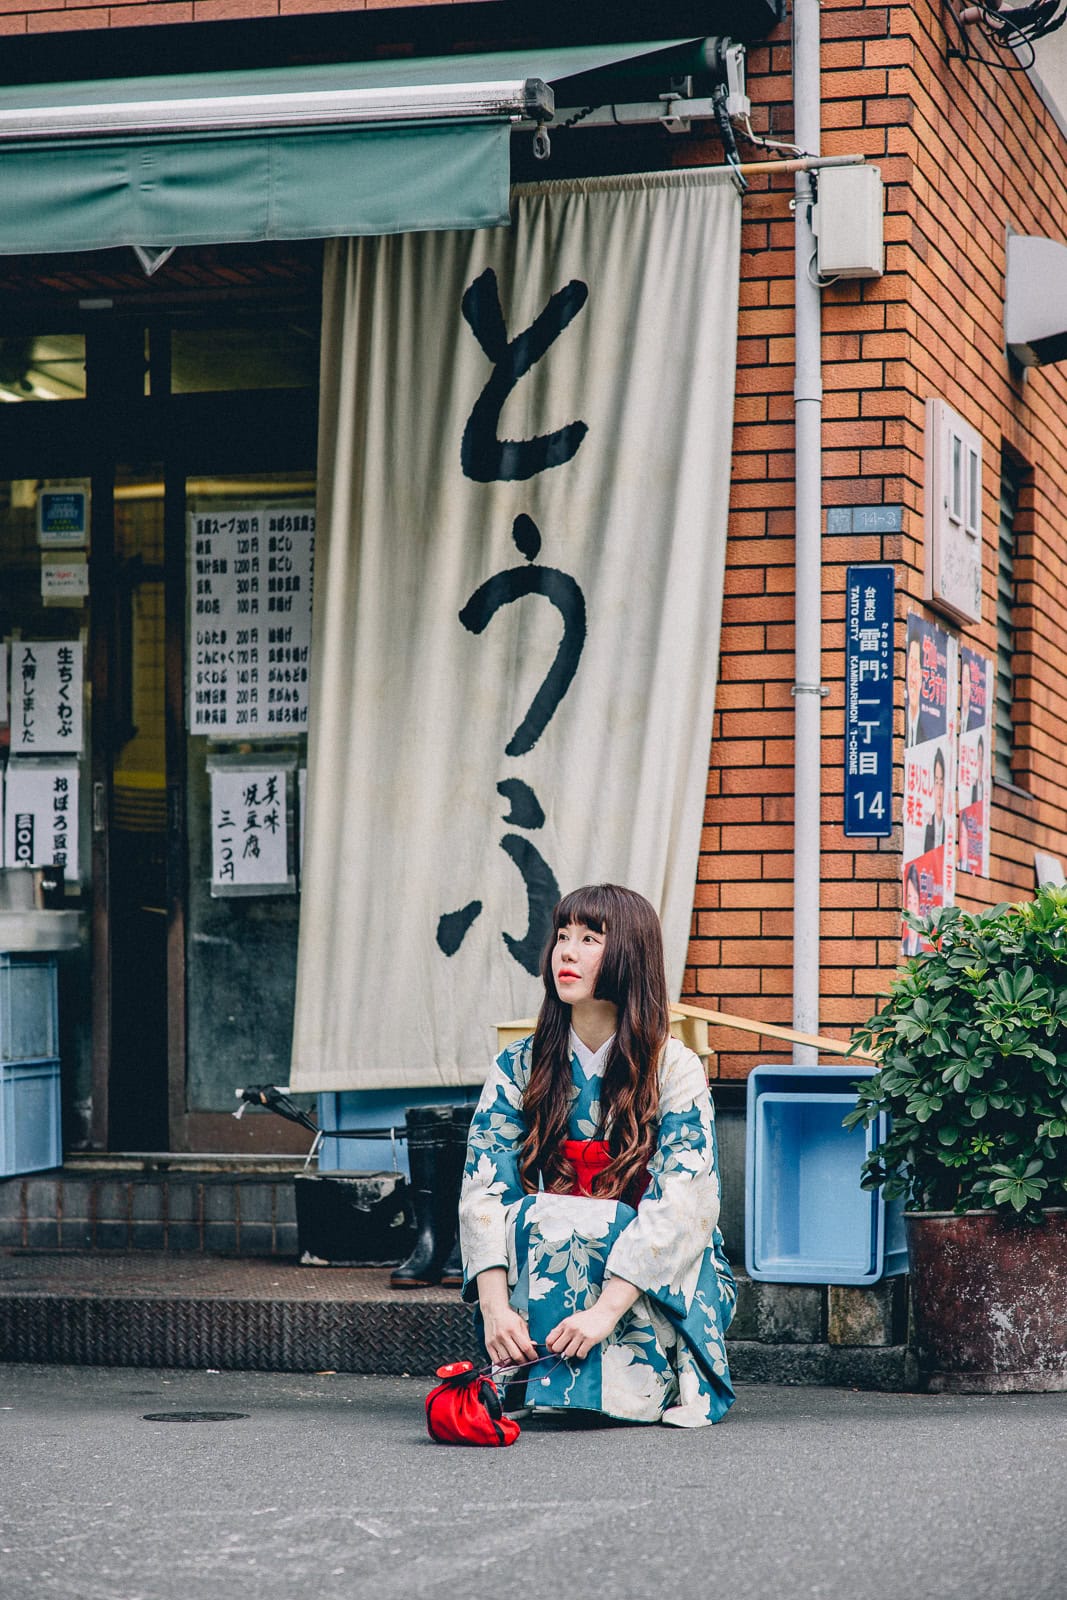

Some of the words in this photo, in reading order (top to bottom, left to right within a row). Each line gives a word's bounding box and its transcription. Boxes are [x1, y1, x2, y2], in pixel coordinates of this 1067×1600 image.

[196, 518, 235, 535] 豆腐スープ
[236, 517, 259, 534] 300円
[269, 515, 308, 532] おぼろ豆腐
[862, 511, 896, 528] 14-3
[237, 537, 258, 554] 120円
[234, 557, 259, 574] 1200円
[236, 577, 258, 594] 300円
[237, 598, 258, 614] 100円
[850, 586, 860, 616] TAITO
[864, 586, 876, 621] 台東区
[437, 267, 589, 977] とうふ
[850, 618, 859, 641] CITY
[236, 628, 258, 645] 200円
[197, 650, 234, 665] こんにゃく
[237, 668, 258, 684] 140円
[268, 667, 307, 682] がんもどき
[22, 647, 37, 743] 入荷しました
[57, 647, 73, 737] 生ちくわぶ
[236, 688, 258, 704] 200円
[849, 656, 859, 722] KAMINARIMON
[857, 628, 881, 776] 雷門一丁目
[236, 708, 258, 724] 200円
[848, 730, 858, 775] 1-CHOME
[261, 775, 280, 834] 美味
[853, 791, 886, 819] 14
[16, 815, 33, 864] 三〇〇
